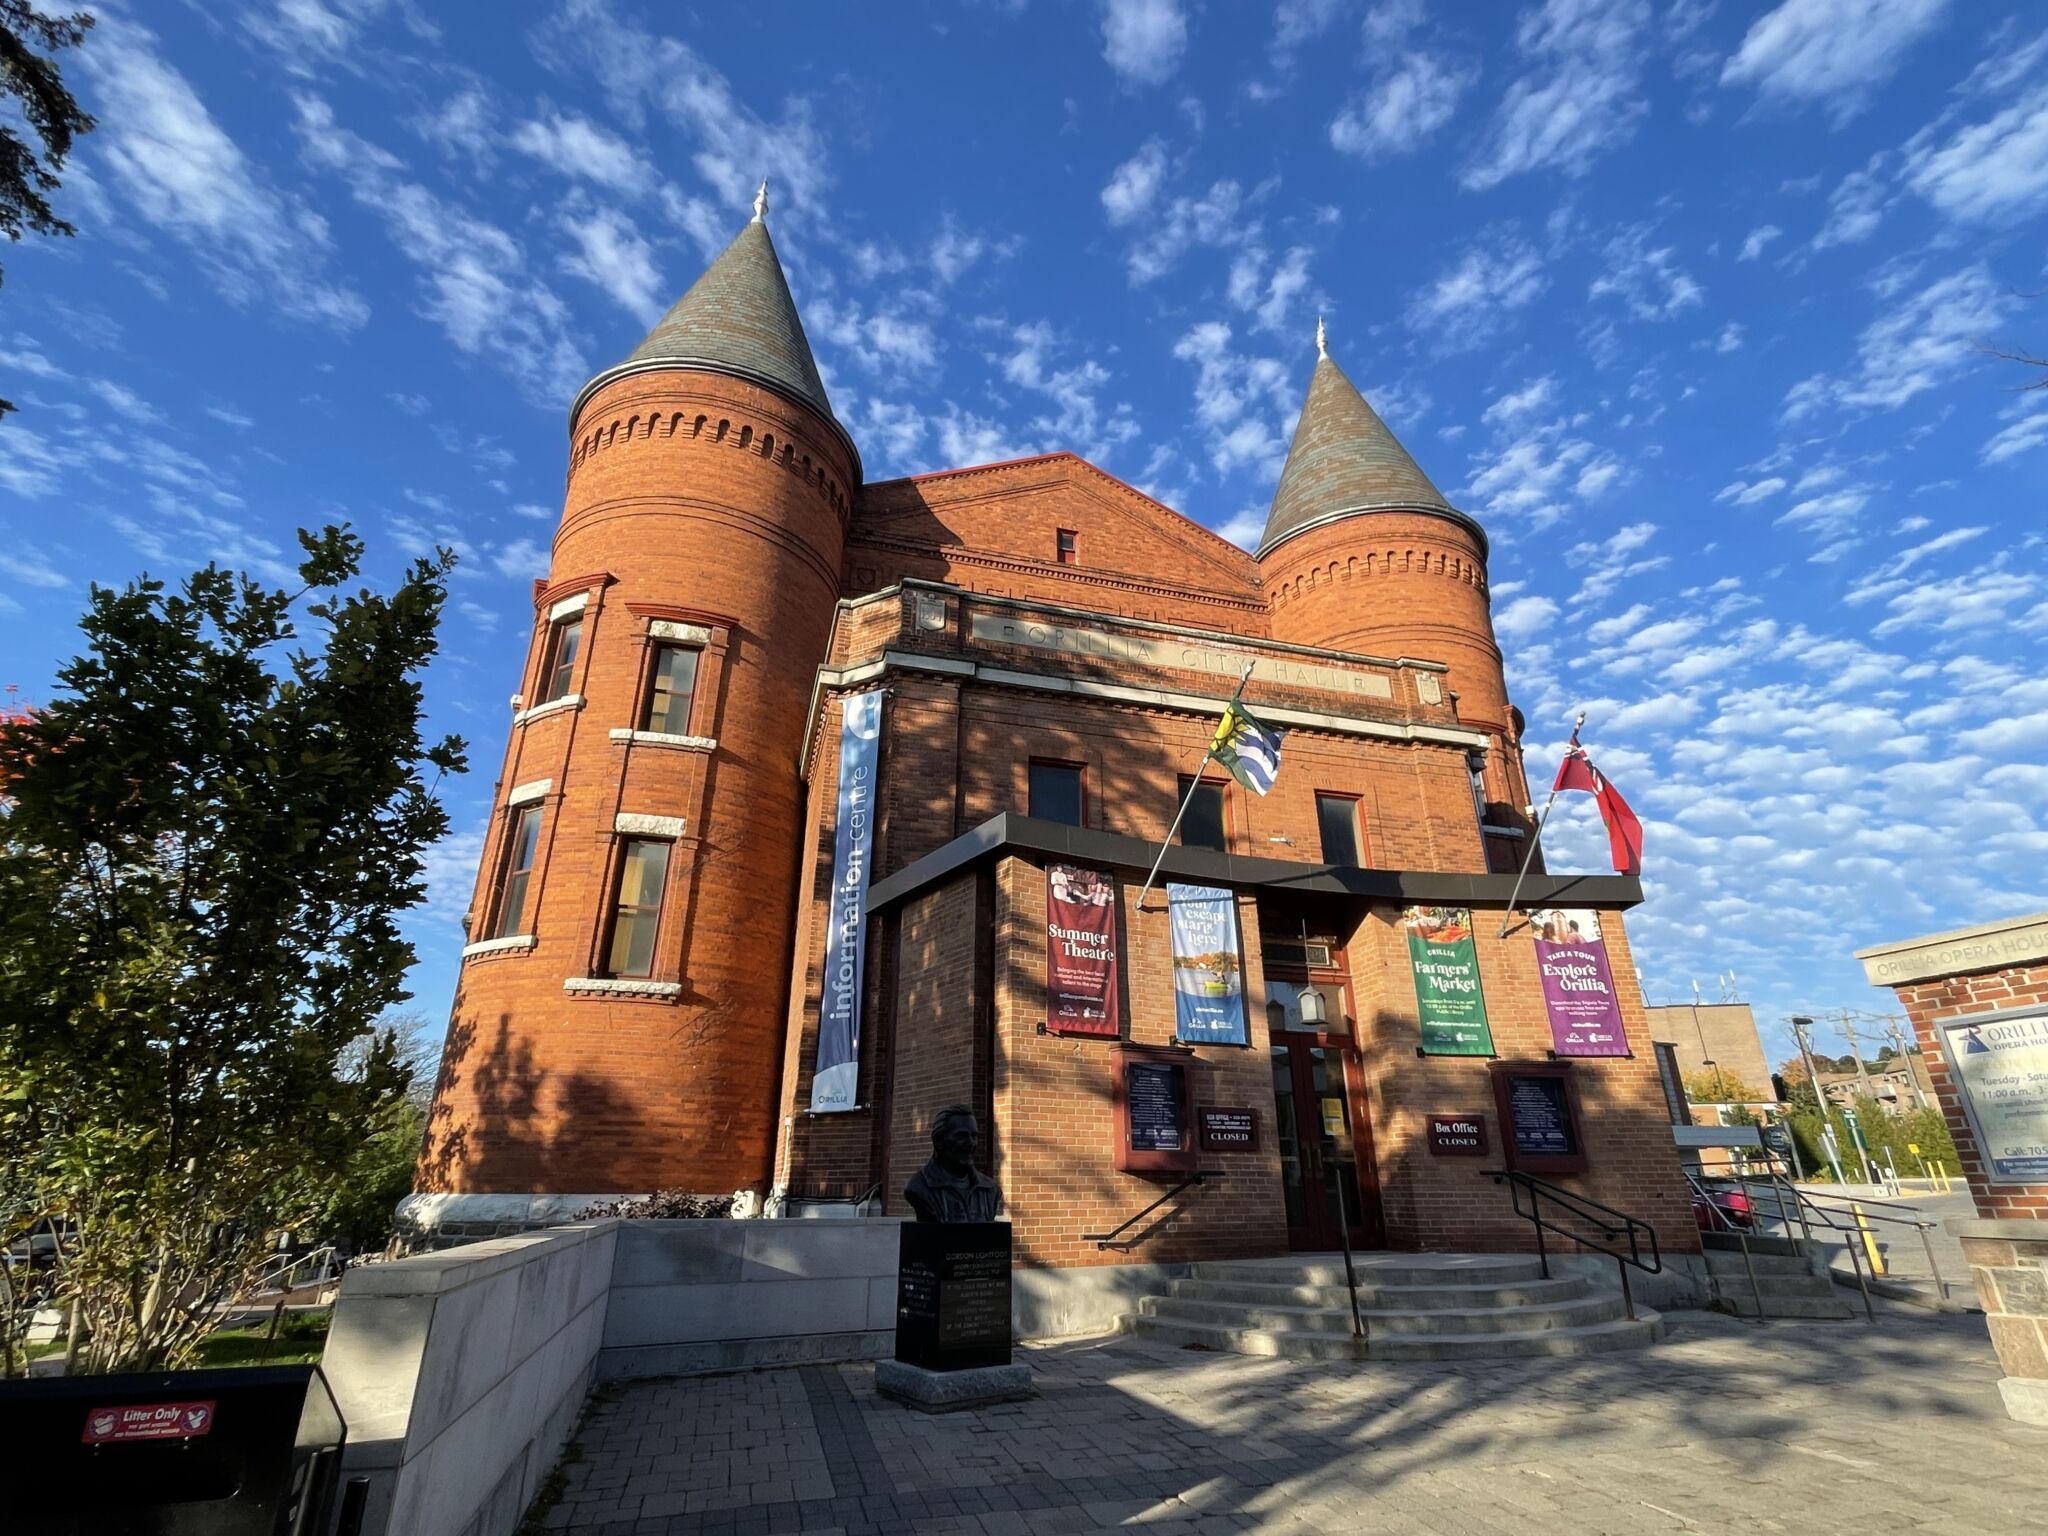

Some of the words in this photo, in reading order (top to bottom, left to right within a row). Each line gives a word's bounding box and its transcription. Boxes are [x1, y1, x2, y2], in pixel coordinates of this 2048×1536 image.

[1028, 626, 1152, 661] ORILLIA
[1181, 648, 1247, 672] CITY
[1275, 662, 1345, 690] HALL
[828, 847, 864, 1020] information
[849, 764, 869, 839] centre
[1186, 910, 1228, 925] escape
[1177, 919, 1214, 934] starts
[1048, 923, 1109, 947] Summer
[1188, 930, 1218, 946] here
[1061, 939, 1114, 962] Theatre
[1427, 948, 1456, 959] ORILLIA
[1546, 951, 1566, 962] TAKE
[1572, 951, 1596, 962] TOUR
[1877, 954, 1935, 977] ORILLIA
[1939, 943, 1999, 964] OPERA
[1414, 960, 1472, 978] Farmers'
[1542, 963, 1598, 980] Explore
[1429, 975, 1477, 993] Market
[1559, 978, 1610, 995] Orillia
[1994, 1040, 2029, 1051] OPERA
[2030, 1037, 2048, 1047] HO
[1980, 1074, 2020, 1086] Tuesday
[1982, 1088, 2008, 1099] 11:00
[2009, 1088, 2032, 1098] a.m.
[1435, 1122, 1451, 1134] Box
[1453, 1122, 1478, 1134] Office
[1210, 1132, 1249, 1141] CLOSED
[1438, 1137, 1477, 1146] CLOSED
[2004, 1145, 2027, 1156] Call:
[123, 1409, 153, 1422] Litter
[154, 1407, 181, 1421] Only
